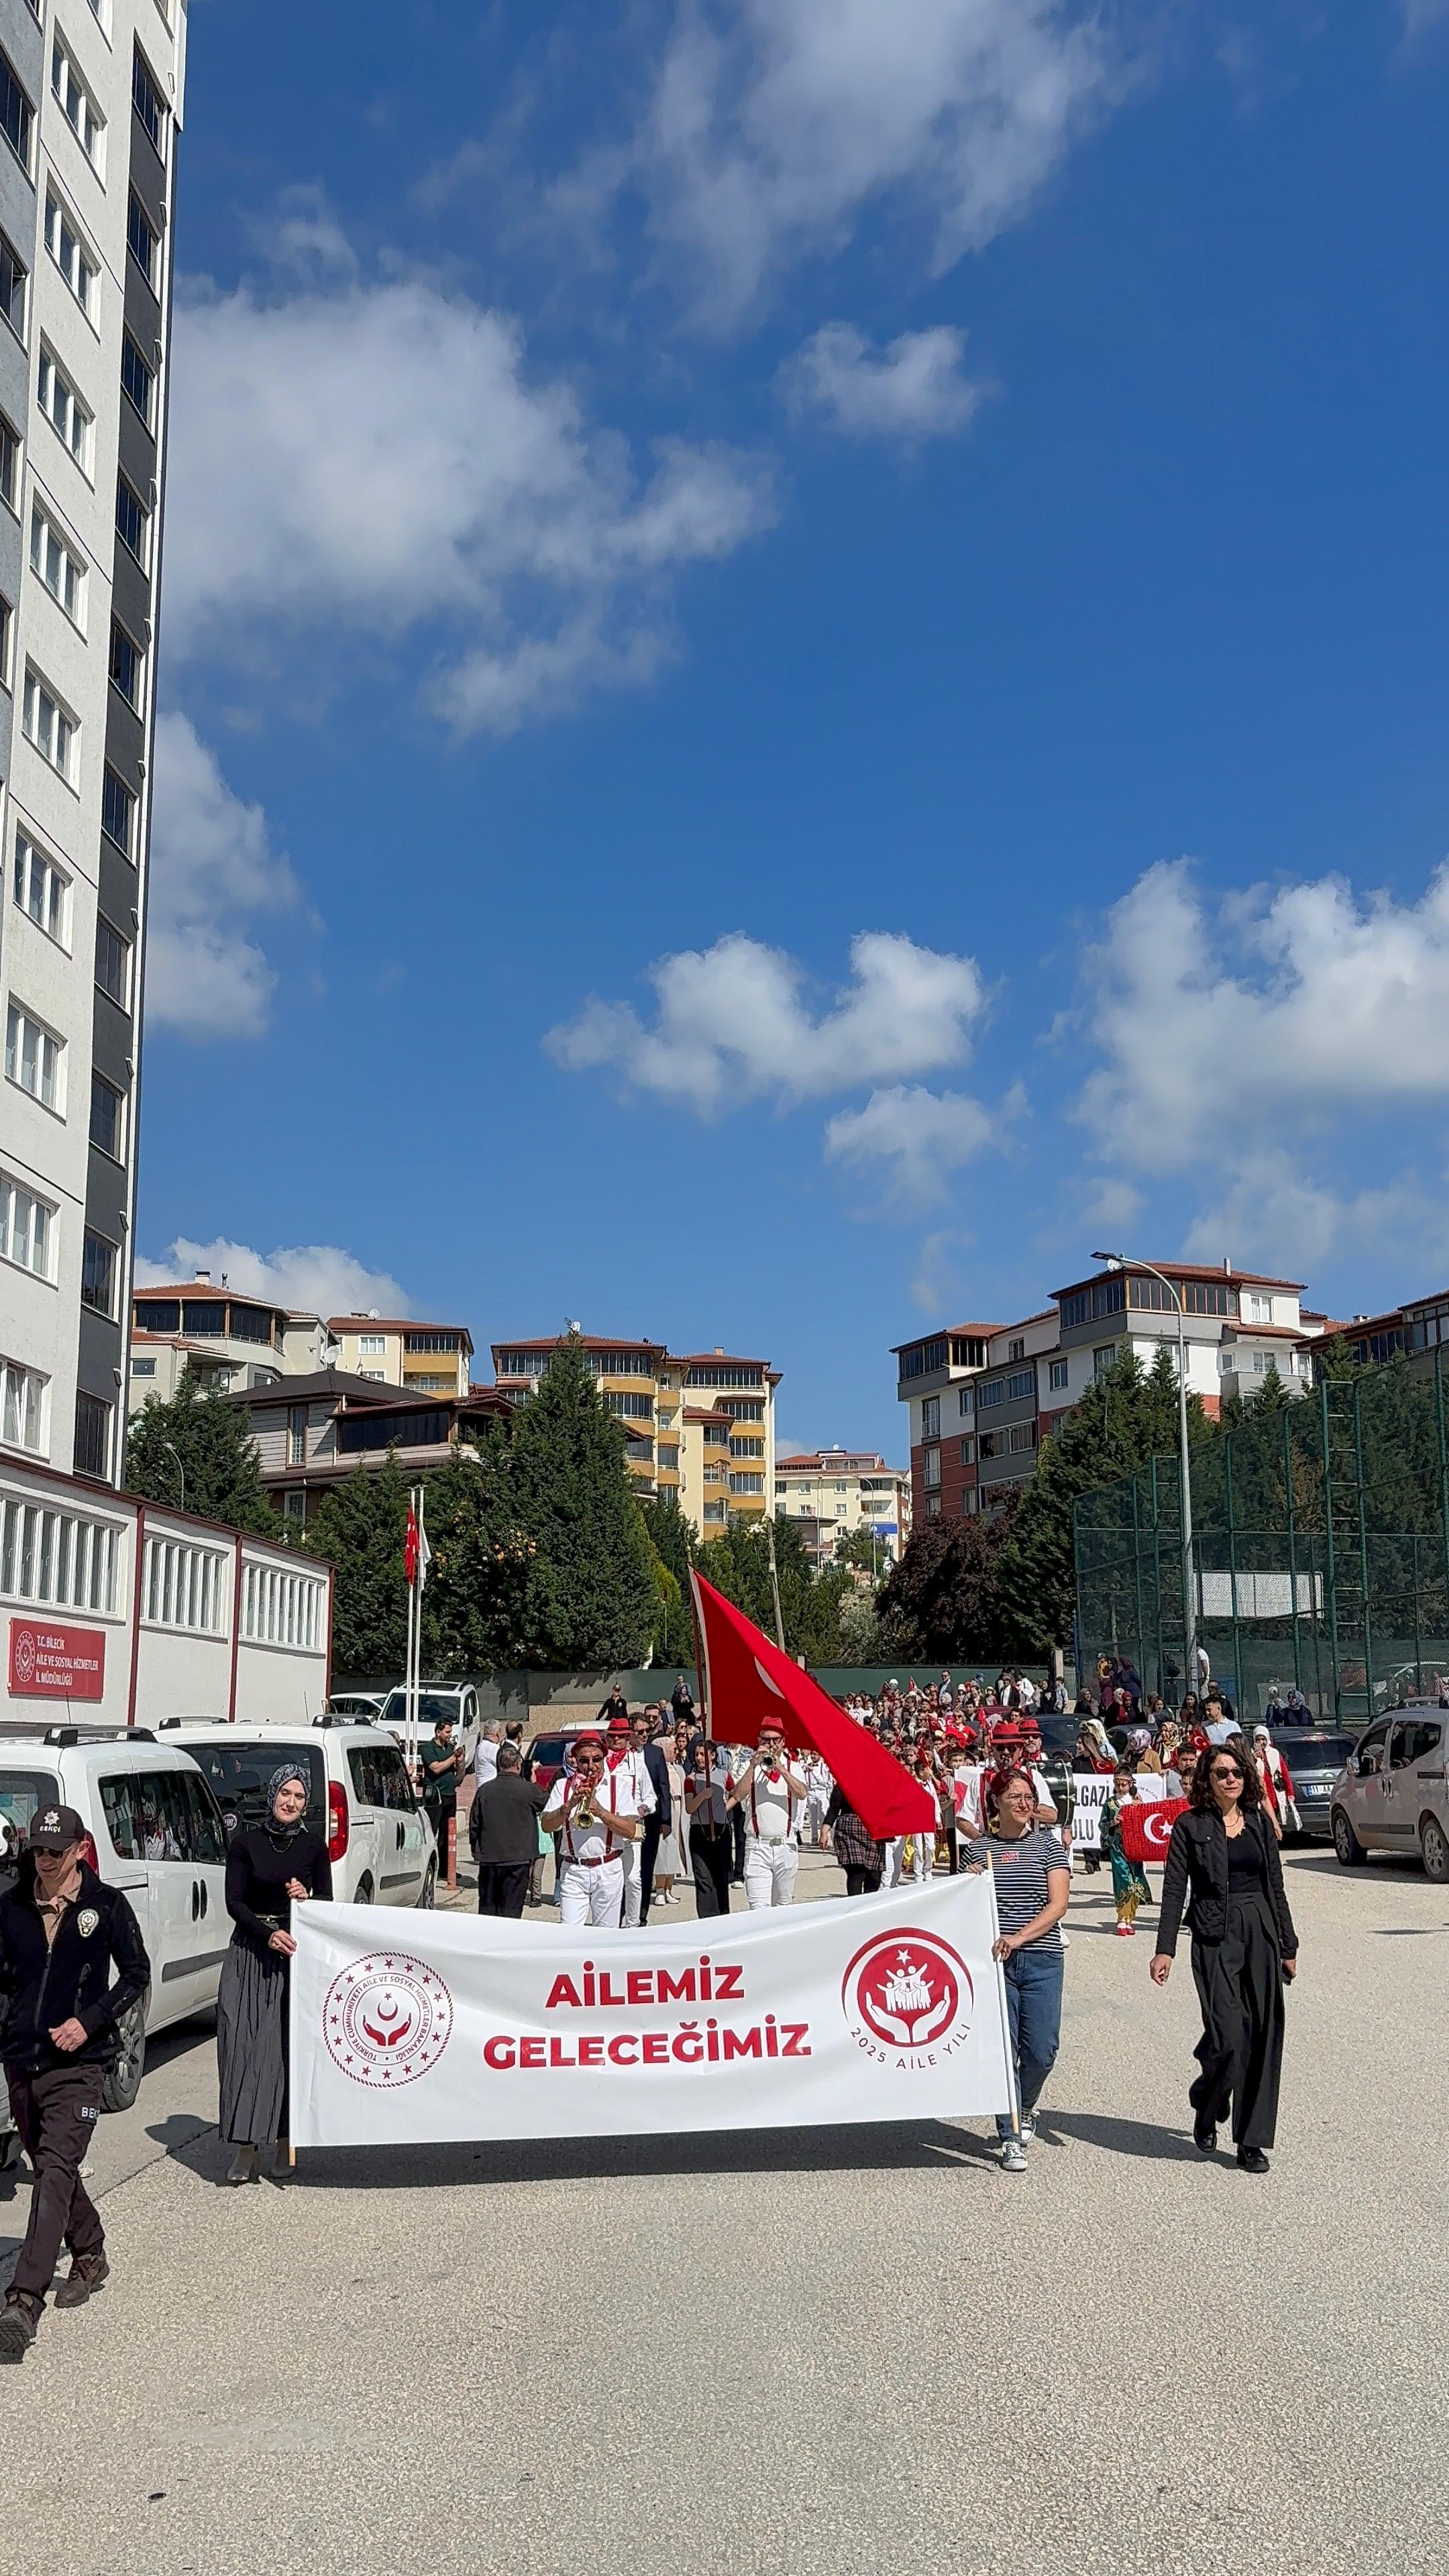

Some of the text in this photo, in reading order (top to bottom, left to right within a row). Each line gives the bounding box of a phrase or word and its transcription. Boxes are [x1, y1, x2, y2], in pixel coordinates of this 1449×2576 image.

[46, 1635, 65, 1650] BİLECİK
[36, 1652, 99, 1671] AİLE VE SOSYAL HİZMETLER
[36, 1669, 72, 1686] İL MÜDÜRLÜĞÜ
[1073, 1780, 1110, 1807] LGAZİ
[363, 1977, 378, 1990] AİLE
[390, 1976, 415, 1991] SOSYAL
[545, 1955, 745, 2008] AİLEMİZ
[345, 1986, 364, 2039] CUMHURİYETİ
[414, 1988, 430, 2027] HİZMETLER
[352, 2037, 377, 2061] TÜRKİYE
[396, 2027, 427, 2061] BAKANLIĞI
[483, 2014, 812, 2070] GELECEĞİMİZ
[850, 2023, 971, 2070] 2025 AİLE YILI
